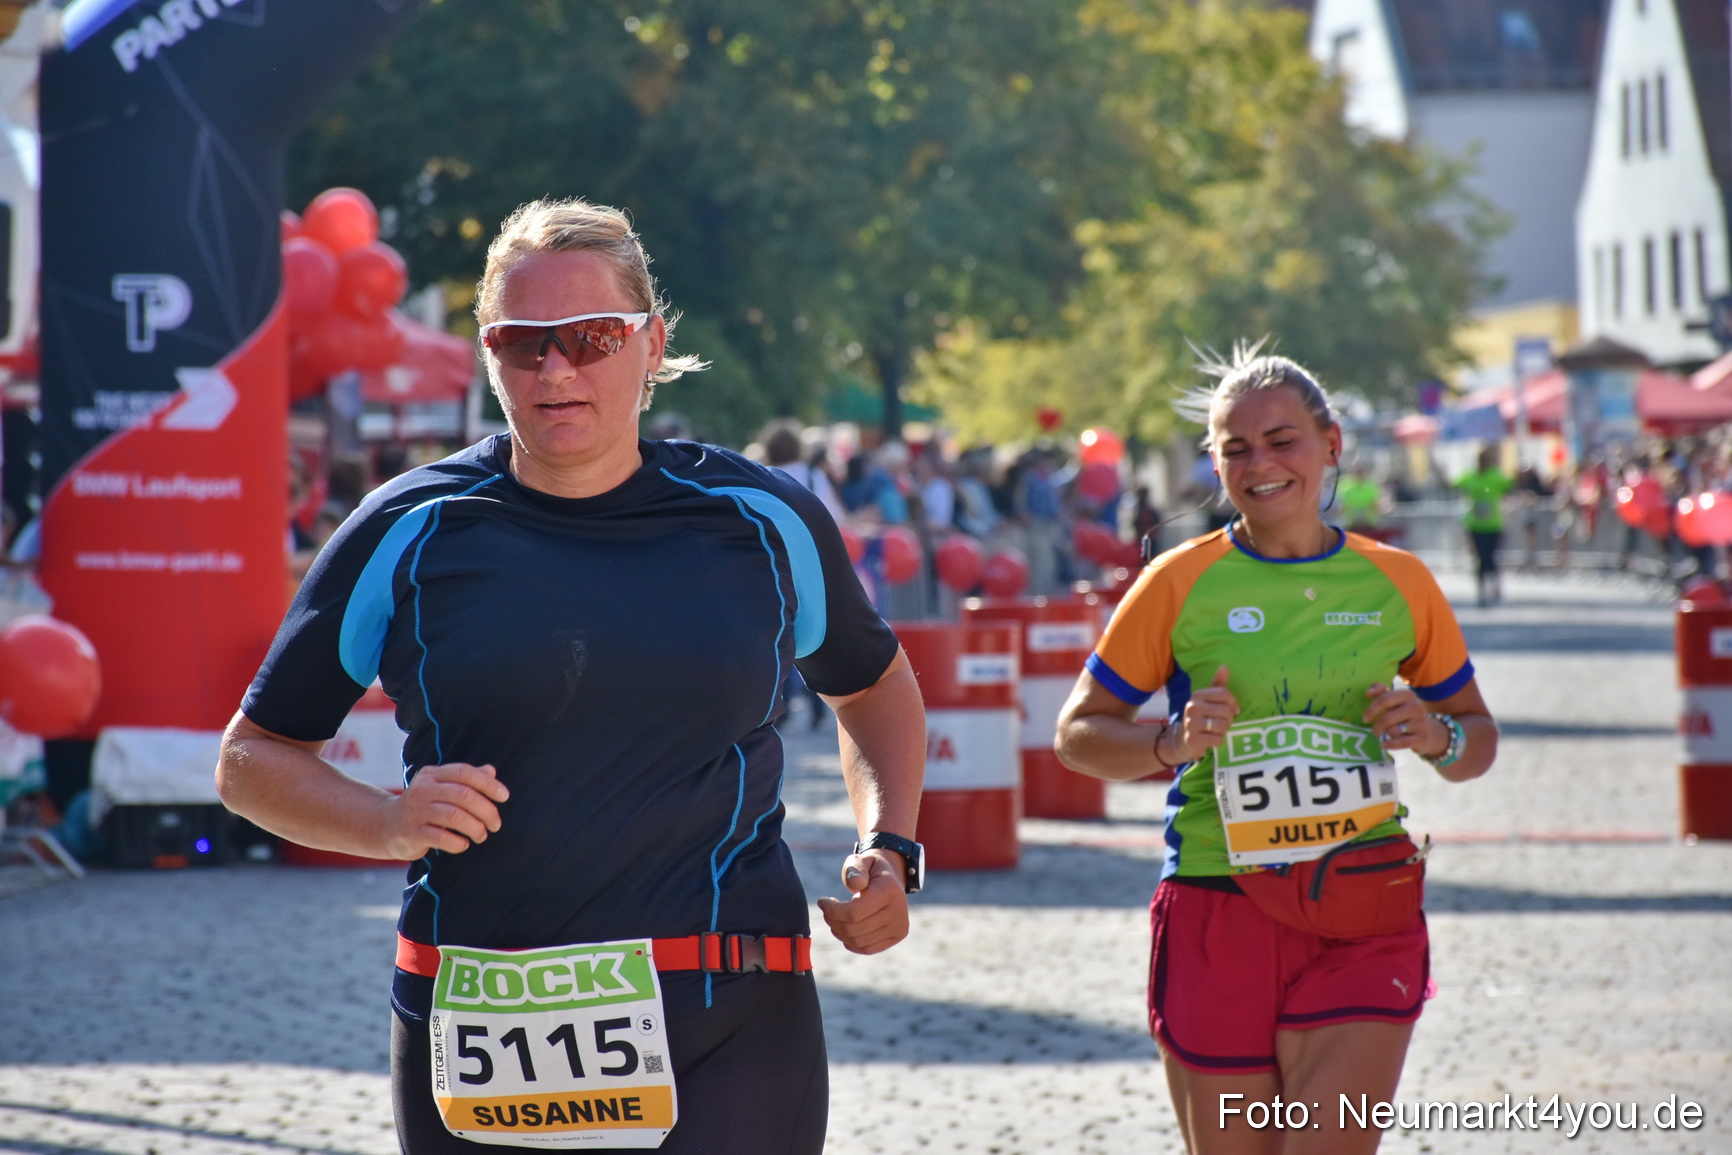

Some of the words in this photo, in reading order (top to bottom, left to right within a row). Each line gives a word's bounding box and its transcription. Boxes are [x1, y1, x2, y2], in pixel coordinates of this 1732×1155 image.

[73, 473, 128, 497] BMW
[132, 473, 241, 502] Laufsport
[1324, 611, 1382, 627] BOCK
[1228, 724, 1373, 762] BOCK
[1238, 765, 1372, 812] 5151
[1269, 818, 1358, 844] JULITA
[446, 953, 638, 1005] BOCK
[457, 1017, 639, 1085] 5115
[472, 1097, 643, 1127] SUSANNE
